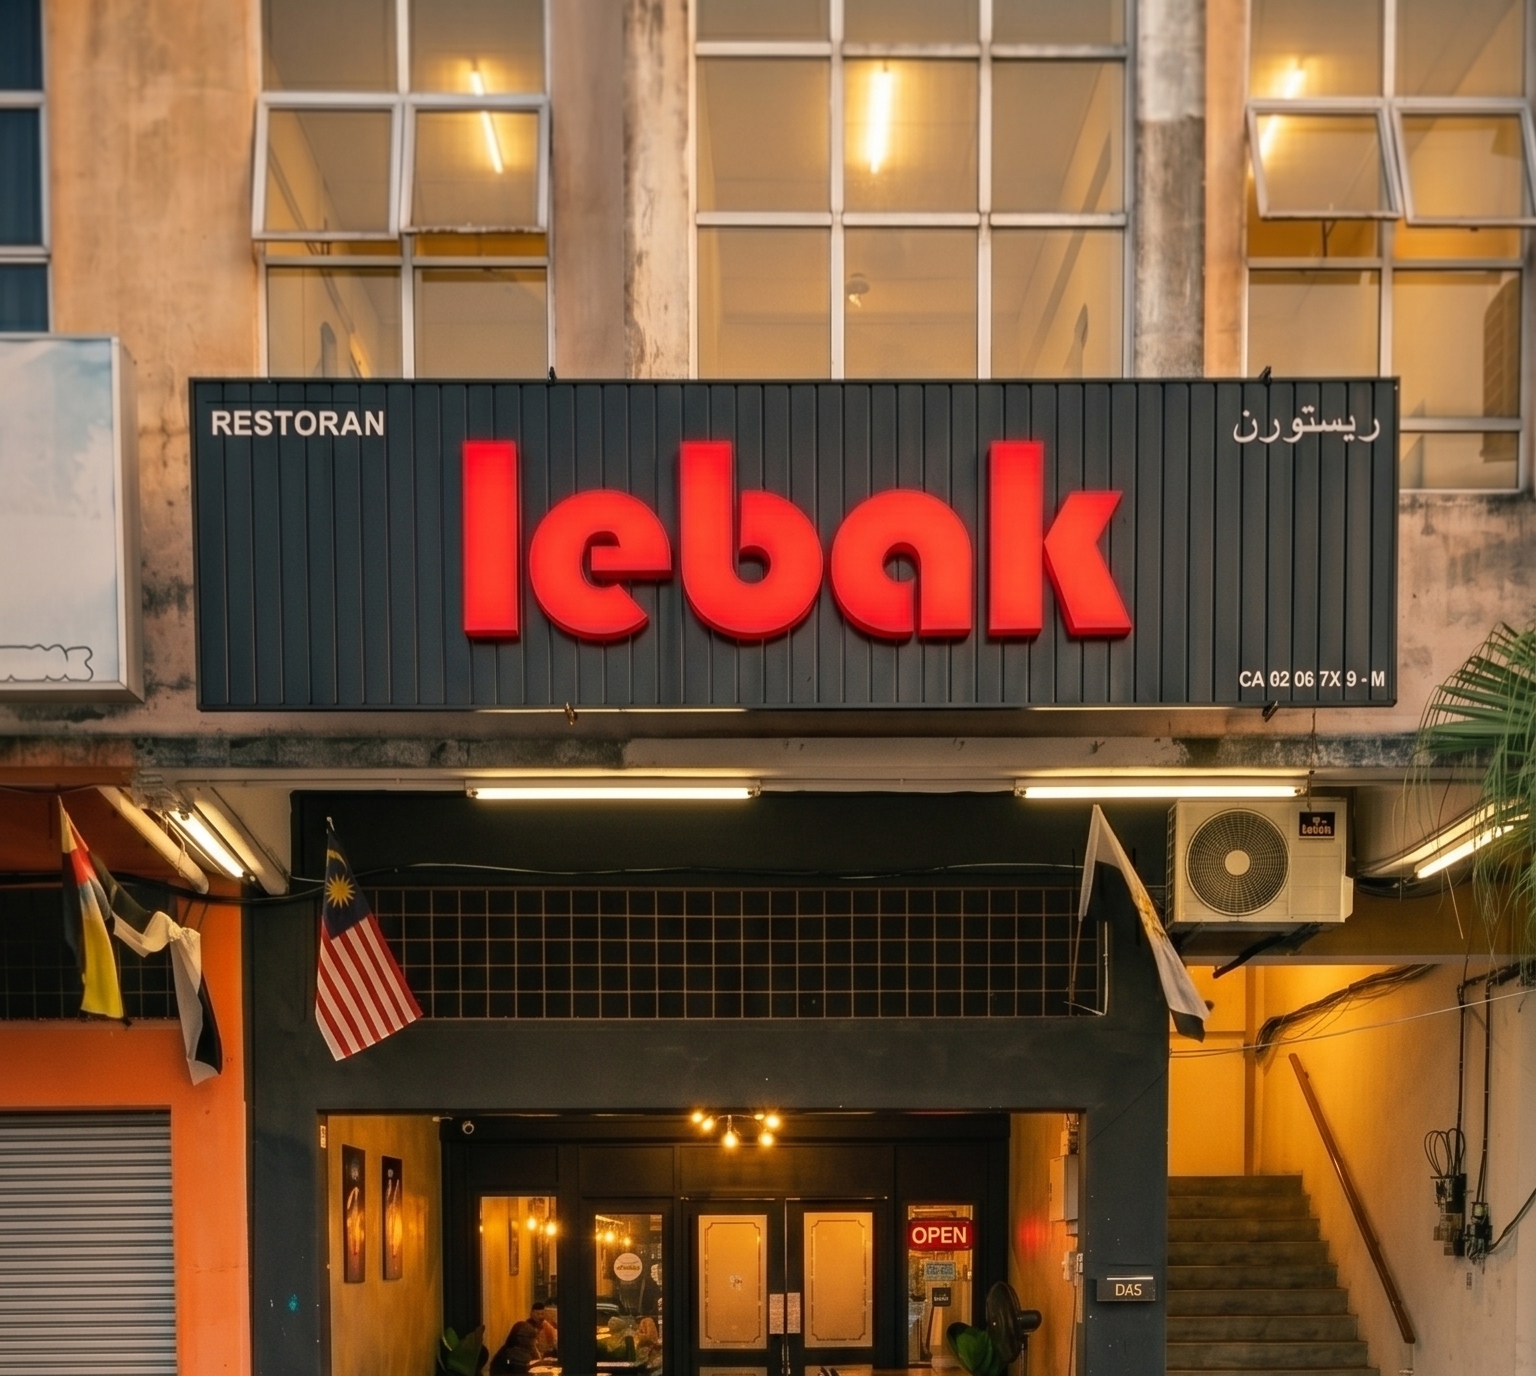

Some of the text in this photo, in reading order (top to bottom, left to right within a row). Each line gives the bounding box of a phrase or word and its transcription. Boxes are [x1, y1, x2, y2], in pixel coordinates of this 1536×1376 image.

[211, 411, 385, 437] RESTORAN
[1233, 405, 1381, 443] ريستورن
[462, 441, 1133, 643] lebak
[1239, 671, 1265, 687] CA
[1294, 671, 1314, 687] 06
[1319, 671, 1341, 687] 7X
[1346, 671, 1357, 687] 9
[1371, 671, 1385, 687] M
[912, 1227, 967, 1244] OPEN
[1115, 1283, 1142, 1296] DAS
